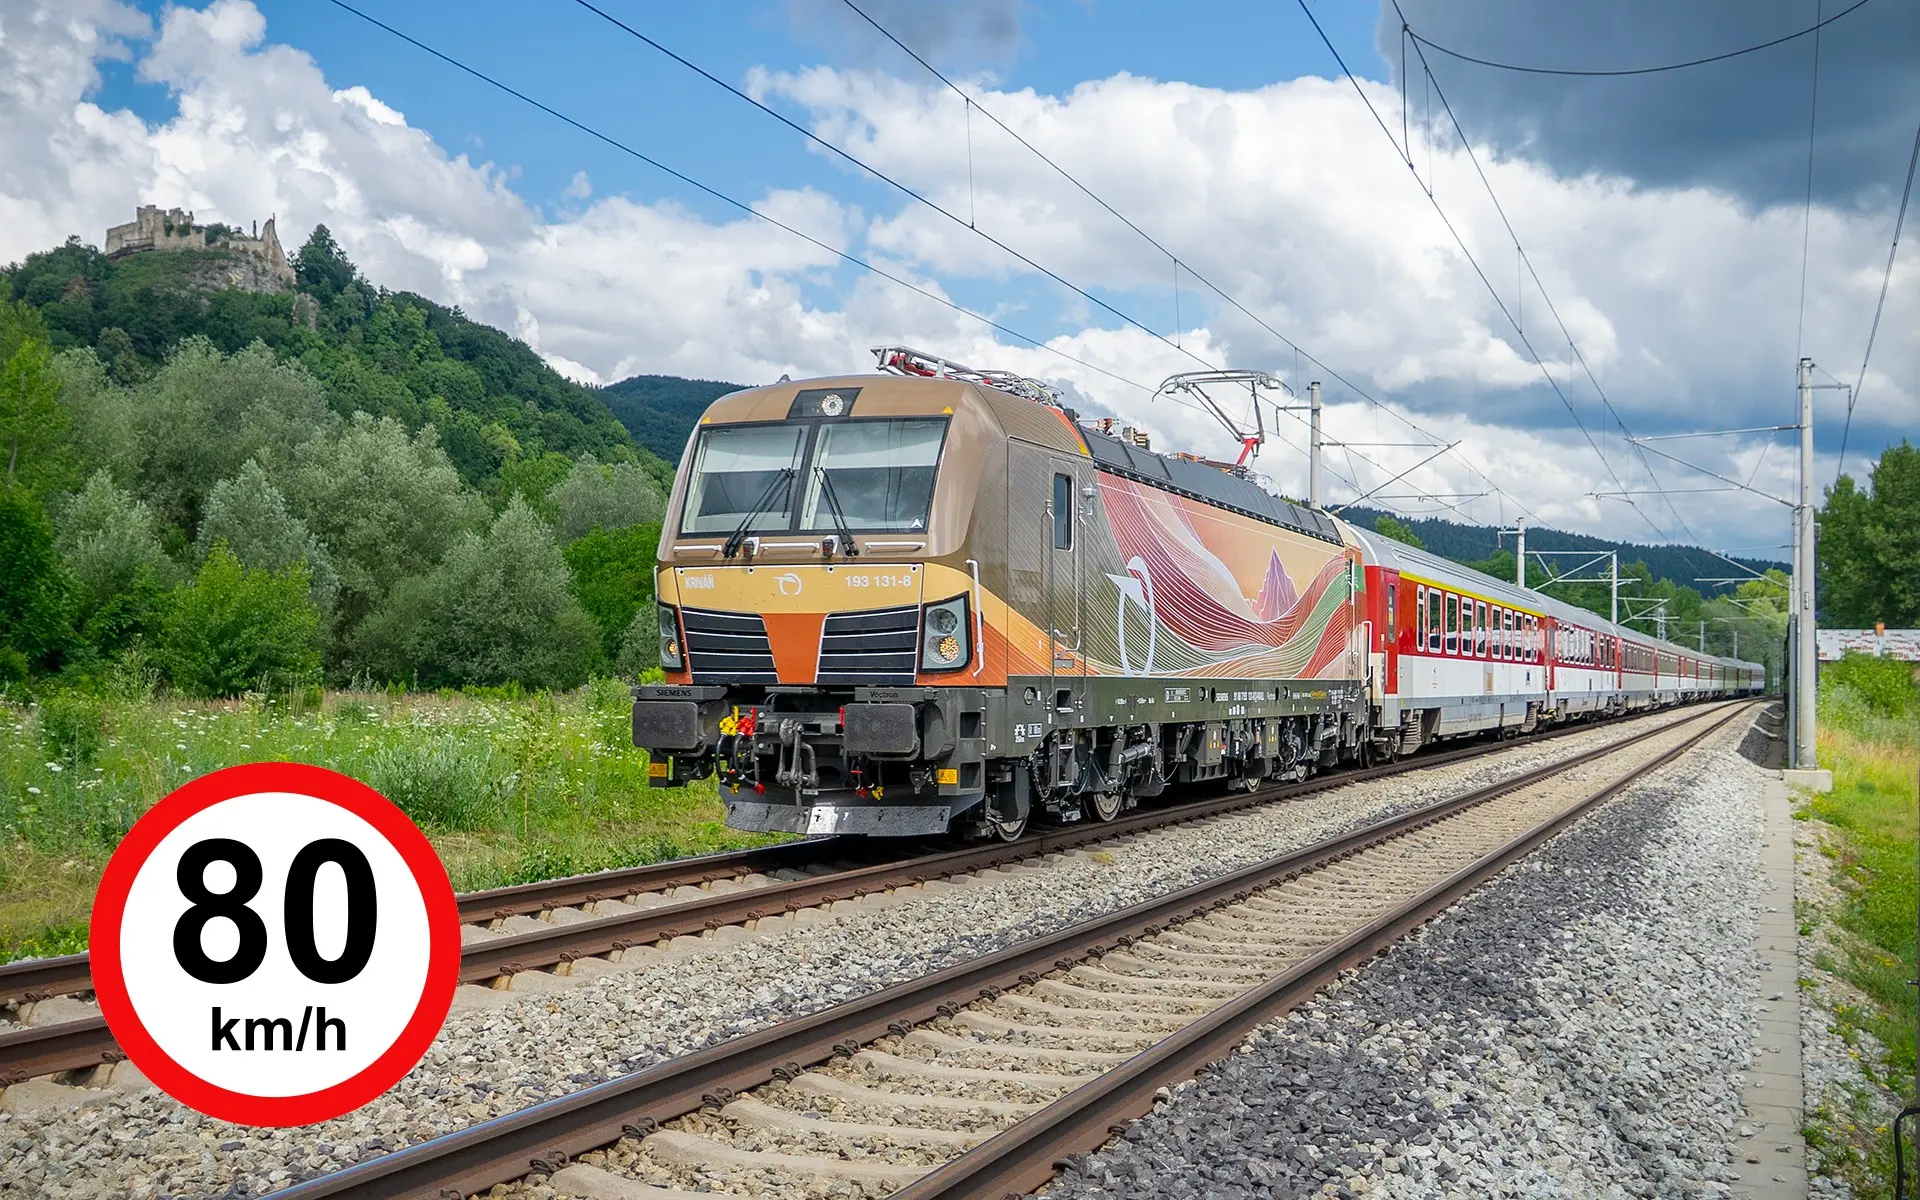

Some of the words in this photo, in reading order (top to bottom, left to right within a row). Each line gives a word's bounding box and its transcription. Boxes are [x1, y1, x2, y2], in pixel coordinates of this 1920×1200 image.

[845, 575, 870, 588] 193
[873, 575, 912, 588] 131-8
[656, 689, 693, 697] SIEMENS
[869, 690, 899, 699] Vectron
